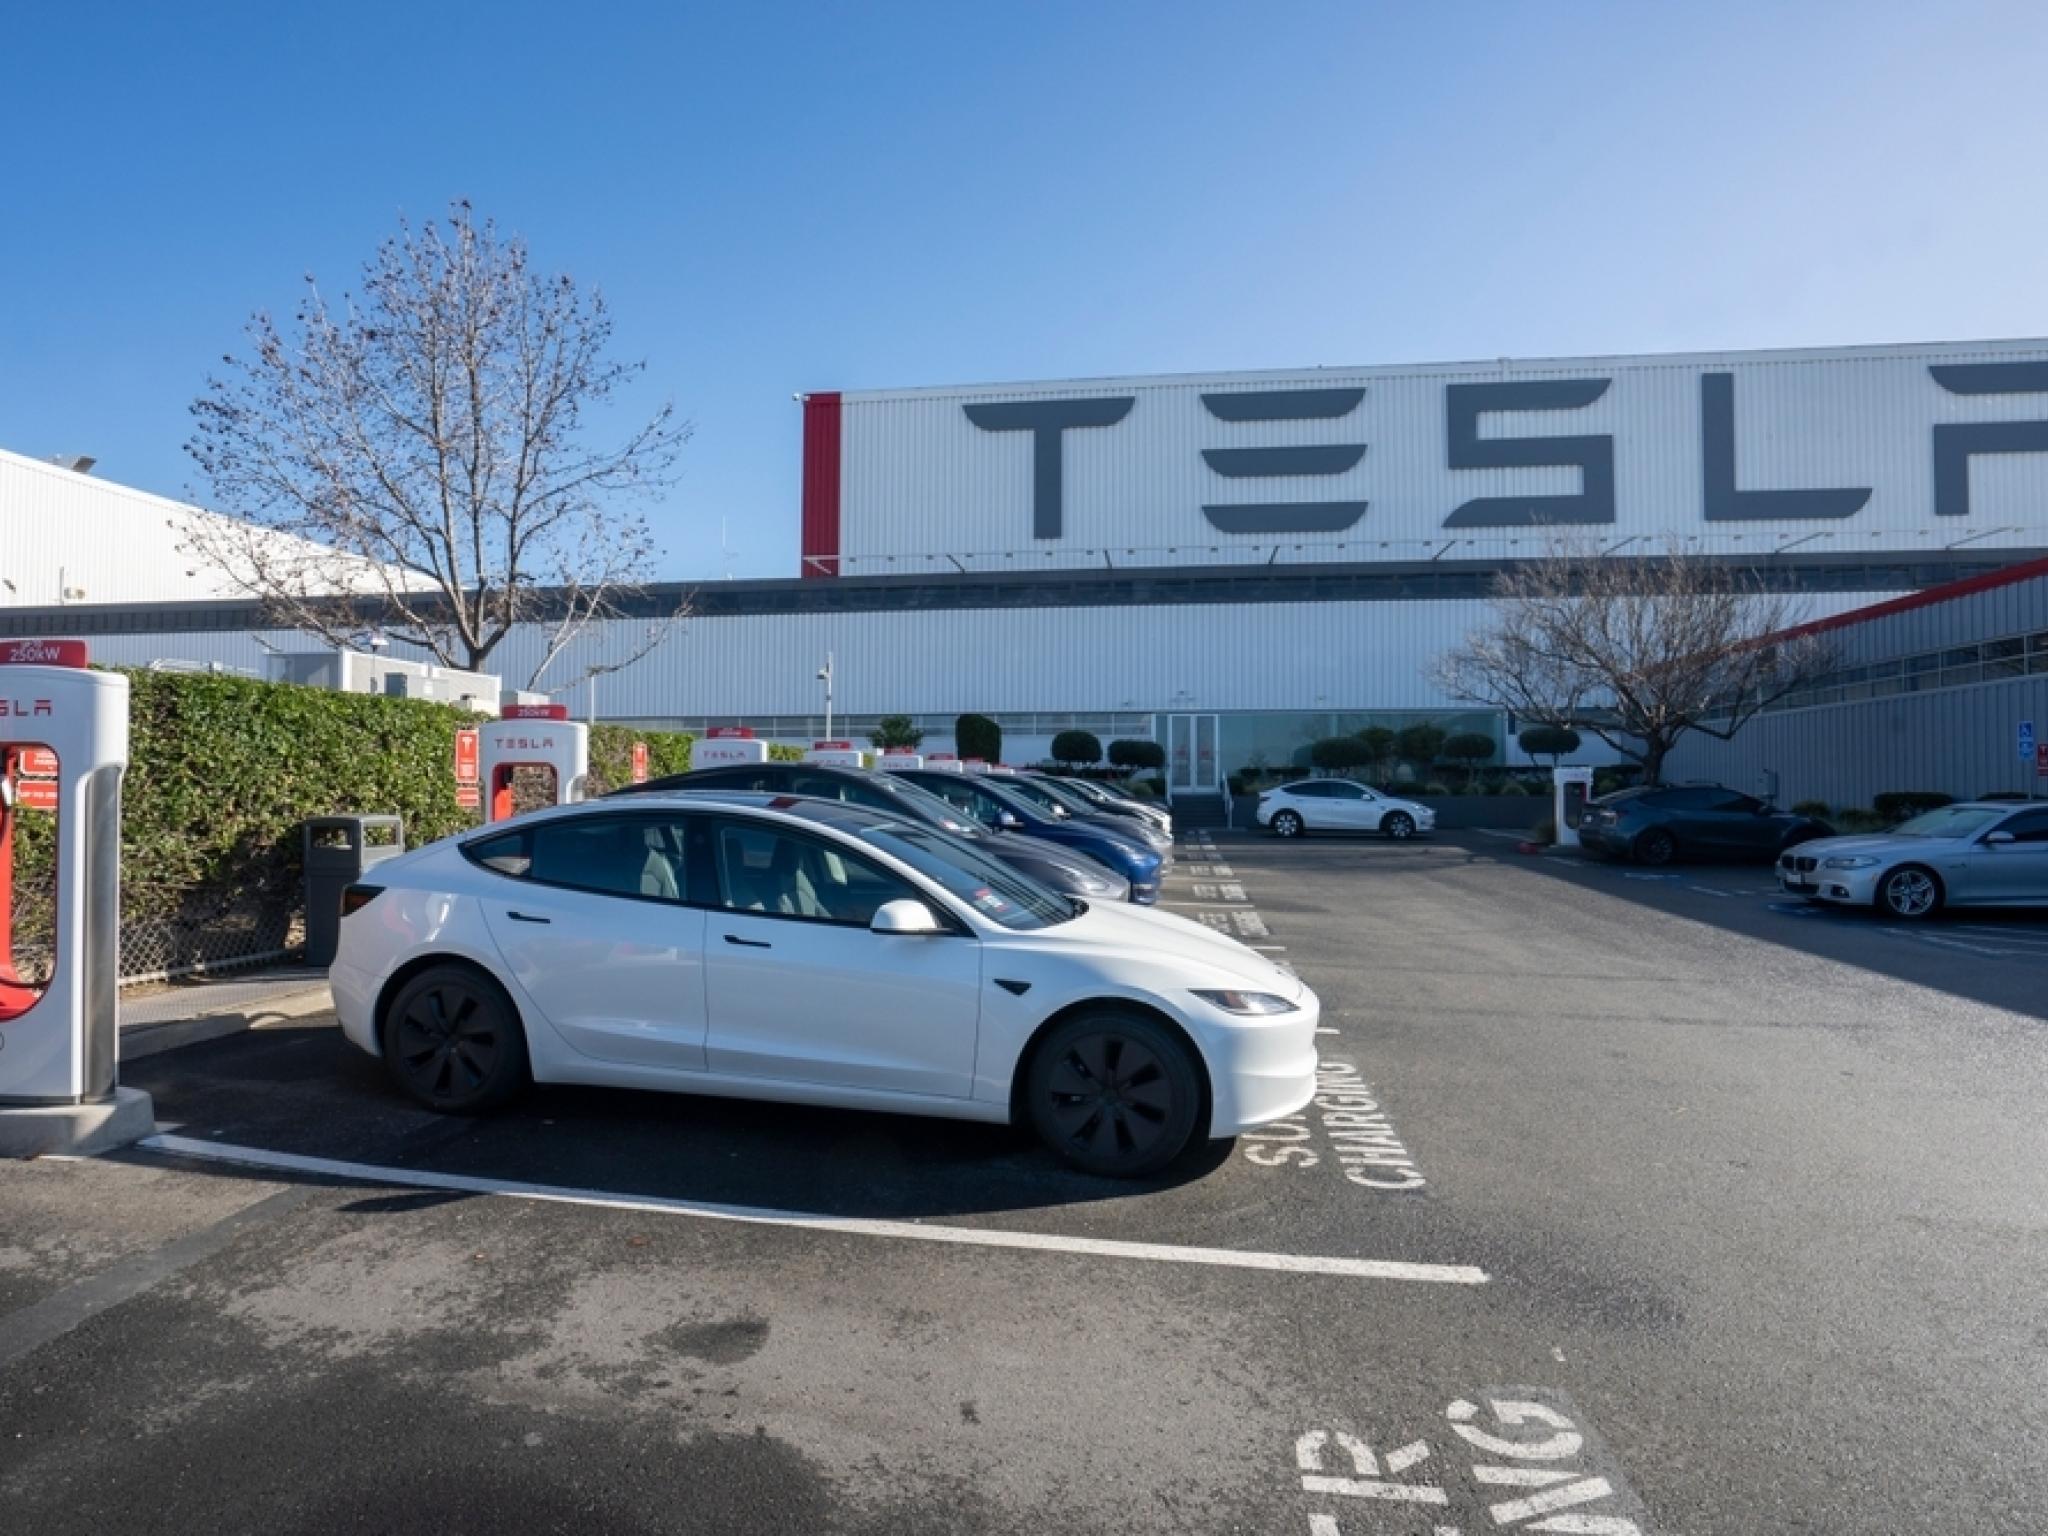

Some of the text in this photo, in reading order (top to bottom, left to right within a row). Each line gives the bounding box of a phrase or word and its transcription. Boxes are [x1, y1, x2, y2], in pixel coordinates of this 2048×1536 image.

[963, 361, 2048, 541] TESLA
[0, 700, 52, 717] SLA
[494, 737, 554, 749] TESLA
